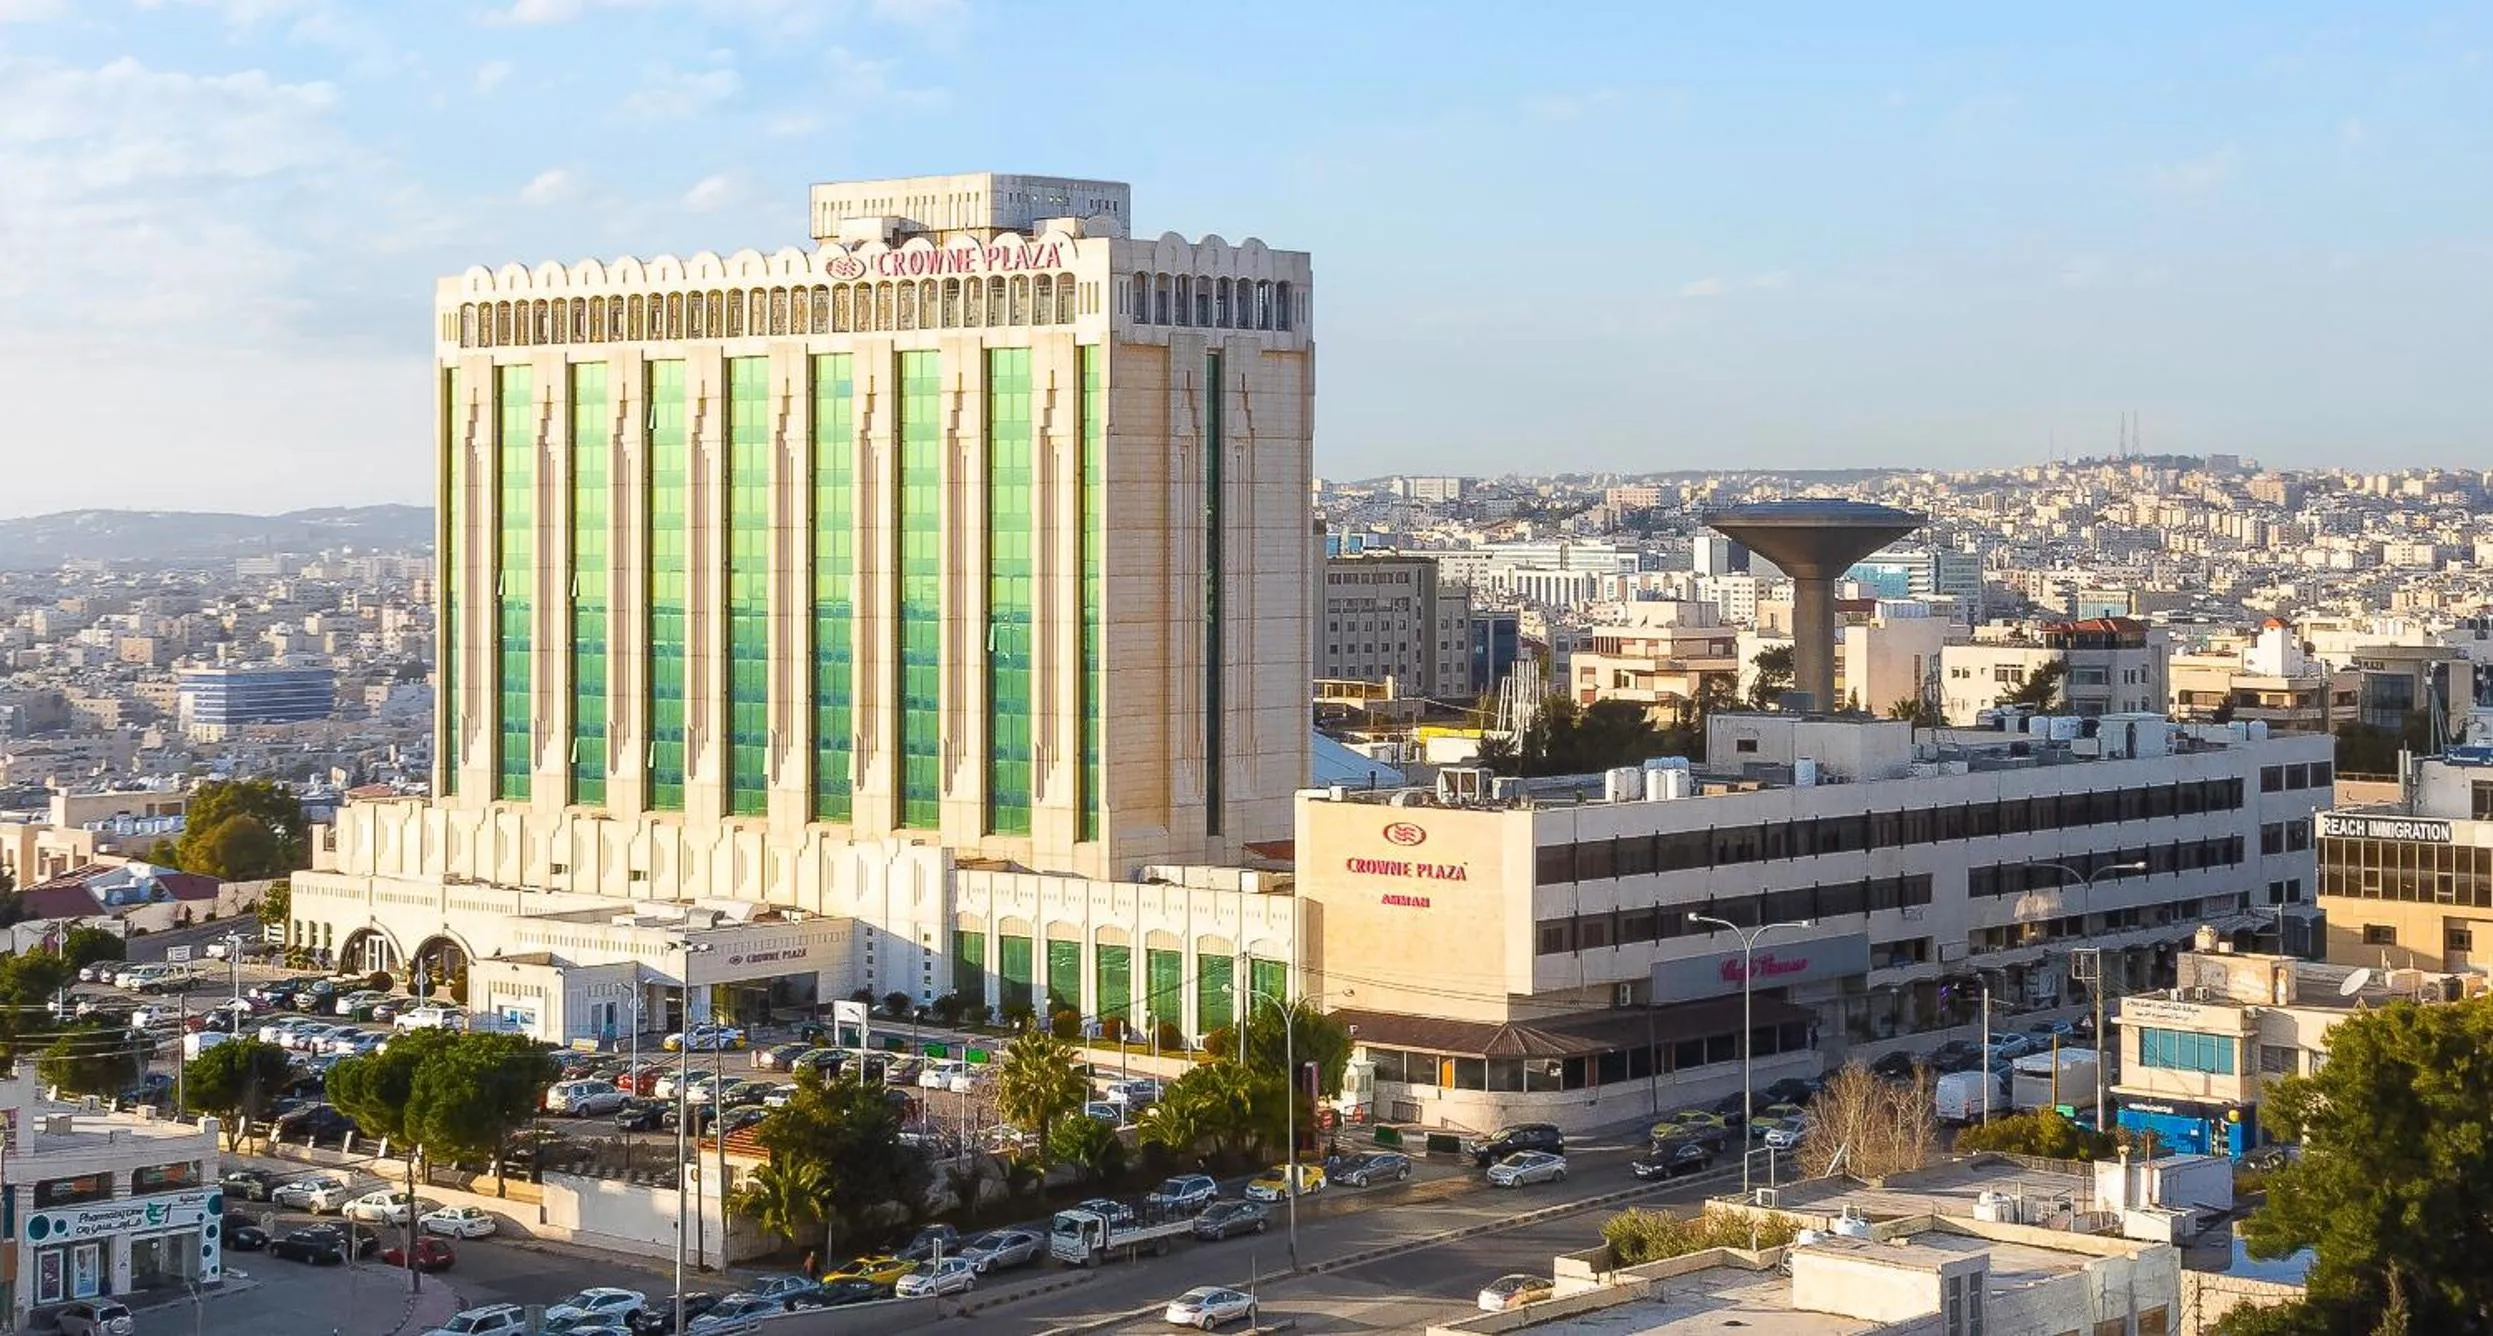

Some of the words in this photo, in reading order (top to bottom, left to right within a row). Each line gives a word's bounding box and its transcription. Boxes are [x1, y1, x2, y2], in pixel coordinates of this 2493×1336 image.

[877, 247, 977, 278] CROWNE
[985, 243, 1063, 272] PLAZA
[2323, 817, 2366, 836] REACH
[2367, 820, 2450, 841] IMMIGRATION
[1346, 857, 1413, 878] CROWNE
[1416, 862, 1467, 881] PLAZA
[1381, 893, 1431, 908] AMMAN
